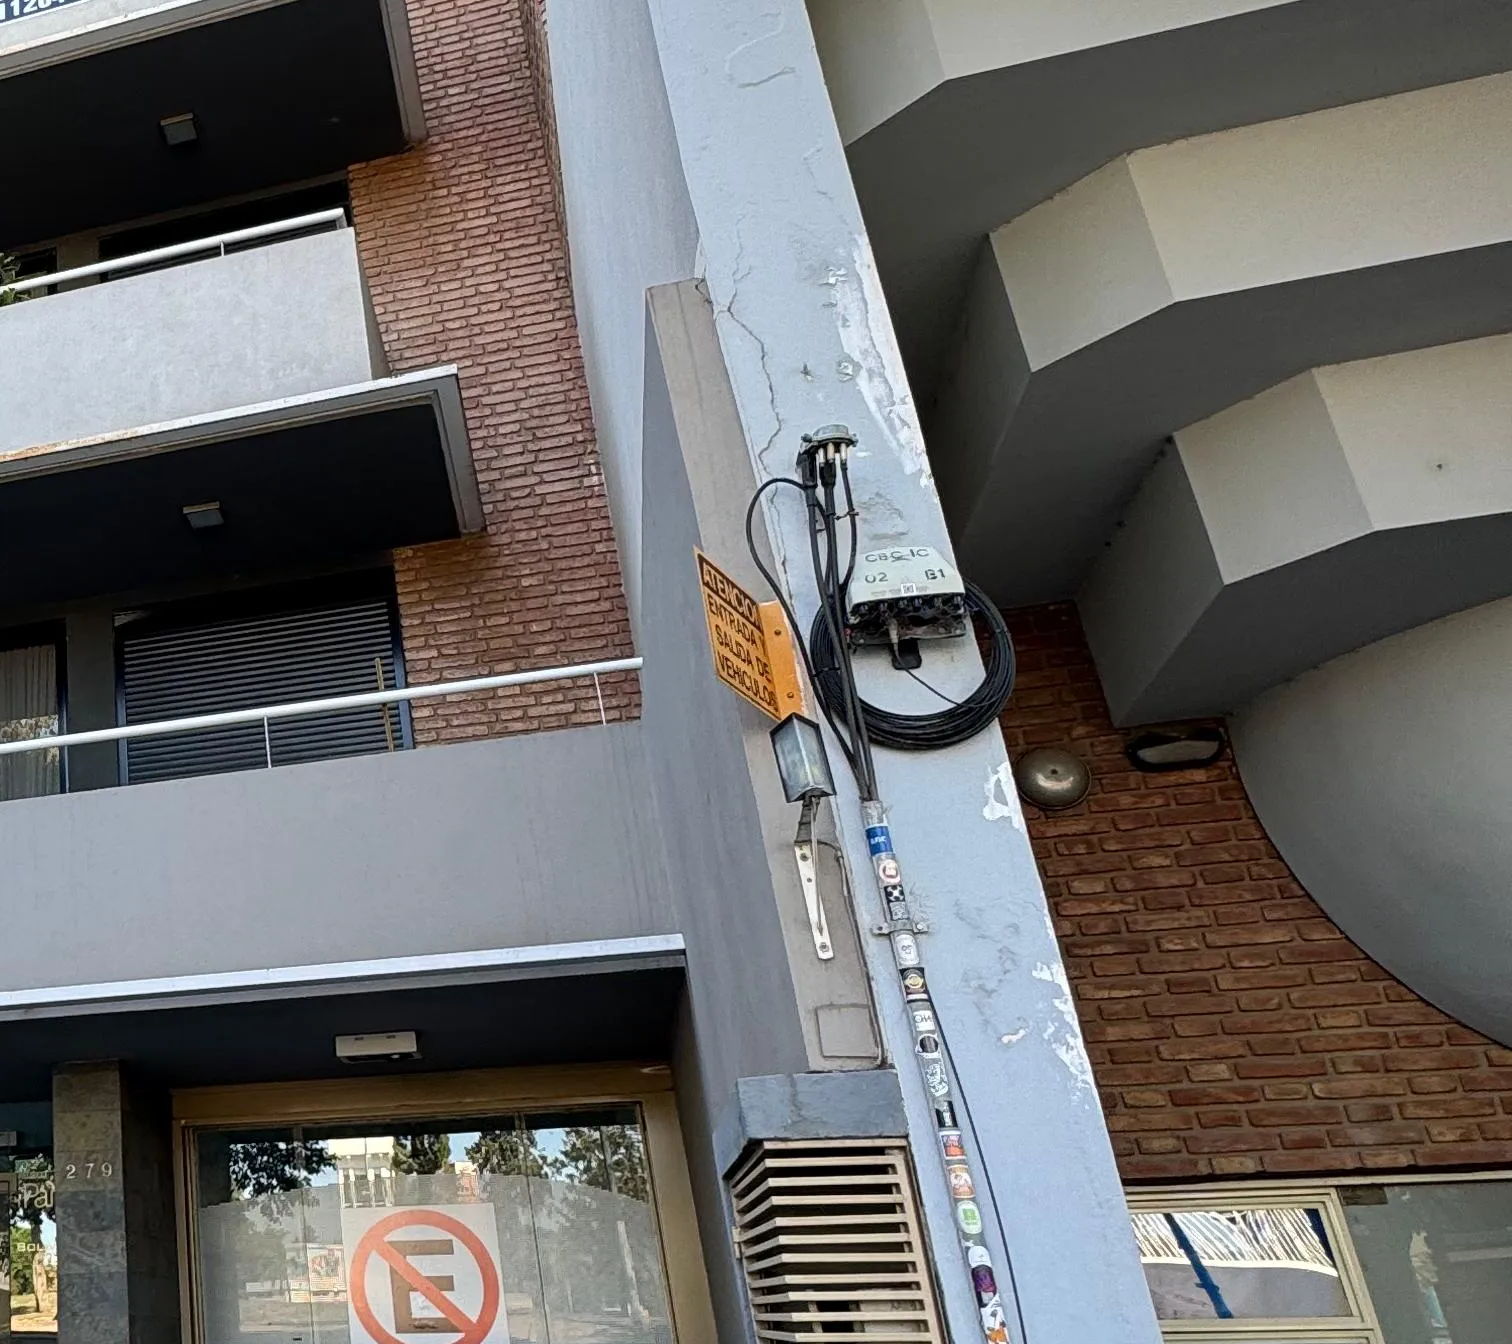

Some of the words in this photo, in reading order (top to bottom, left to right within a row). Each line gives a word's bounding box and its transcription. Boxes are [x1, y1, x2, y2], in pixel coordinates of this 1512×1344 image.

[707, 593, 758, 649] ENTRADA
[715, 624, 754, 671] SALIDA
[756, 657, 773, 683] DE
[66, 1162, 112, 1179] 279
